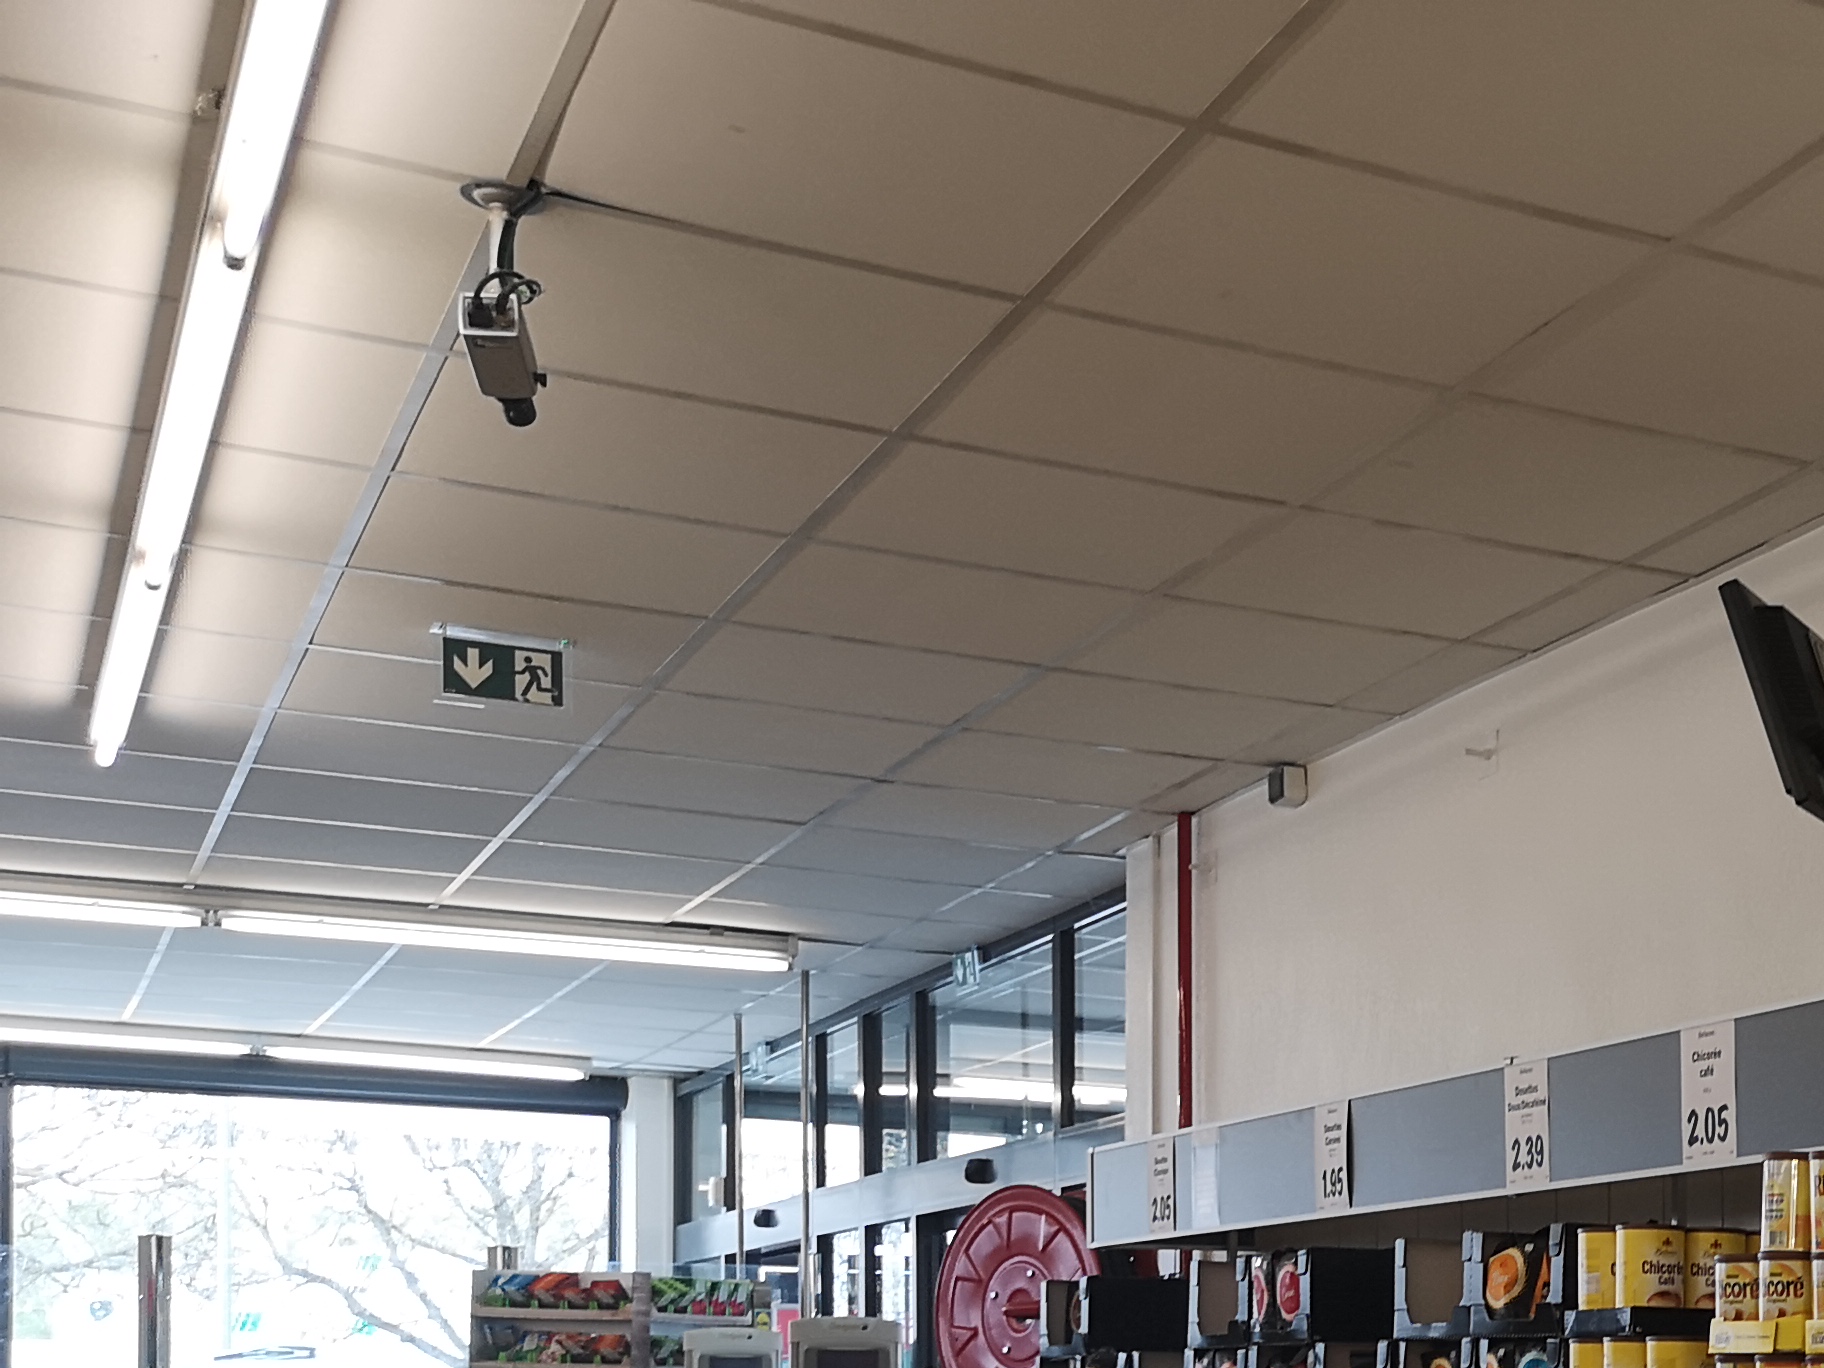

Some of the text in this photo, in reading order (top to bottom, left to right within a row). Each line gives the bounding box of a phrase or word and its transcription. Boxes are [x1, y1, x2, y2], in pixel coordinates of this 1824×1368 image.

[1691, 1047, 1722, 1063] Chicorée
[1699, 1063, 1714, 1078] café
[1687, 1103, 1729, 1148] 2.05
[1511, 1134, 1544, 1173] 2.39
[1322, 1166, 1344, 1199] 1.95
[1151, 1194, 1172, 1224] 2.05
